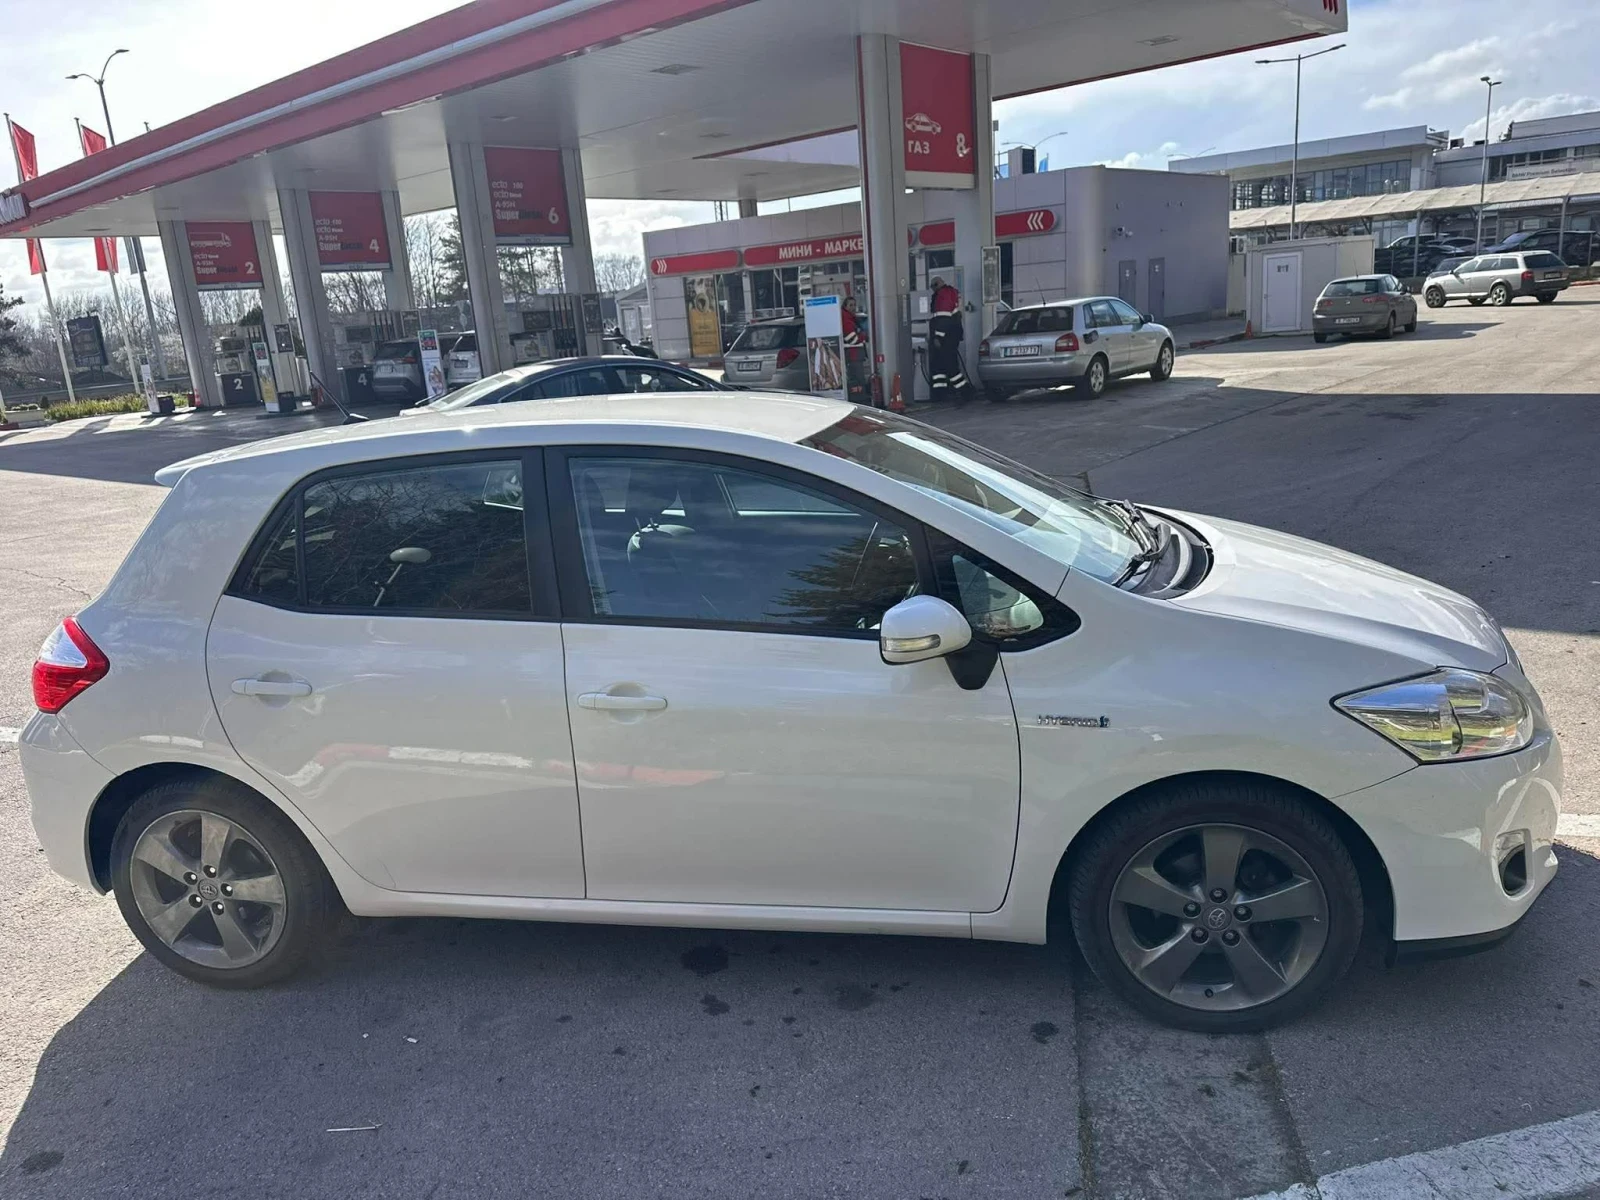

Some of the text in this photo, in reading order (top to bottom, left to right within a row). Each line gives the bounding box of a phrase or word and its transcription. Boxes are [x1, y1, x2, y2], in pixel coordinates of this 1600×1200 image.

[908, 140, 930, 154] ГАЗ
[492, 180, 507, 189] ecto
[548, 207, 559, 224] 6
[369, 238, 379, 253] 4
[779, 244, 812, 259] МИНИ
[245, 261, 255, 275] 2
[234, 378, 243, 390] 2
[358, 373, 367, 386] 4
